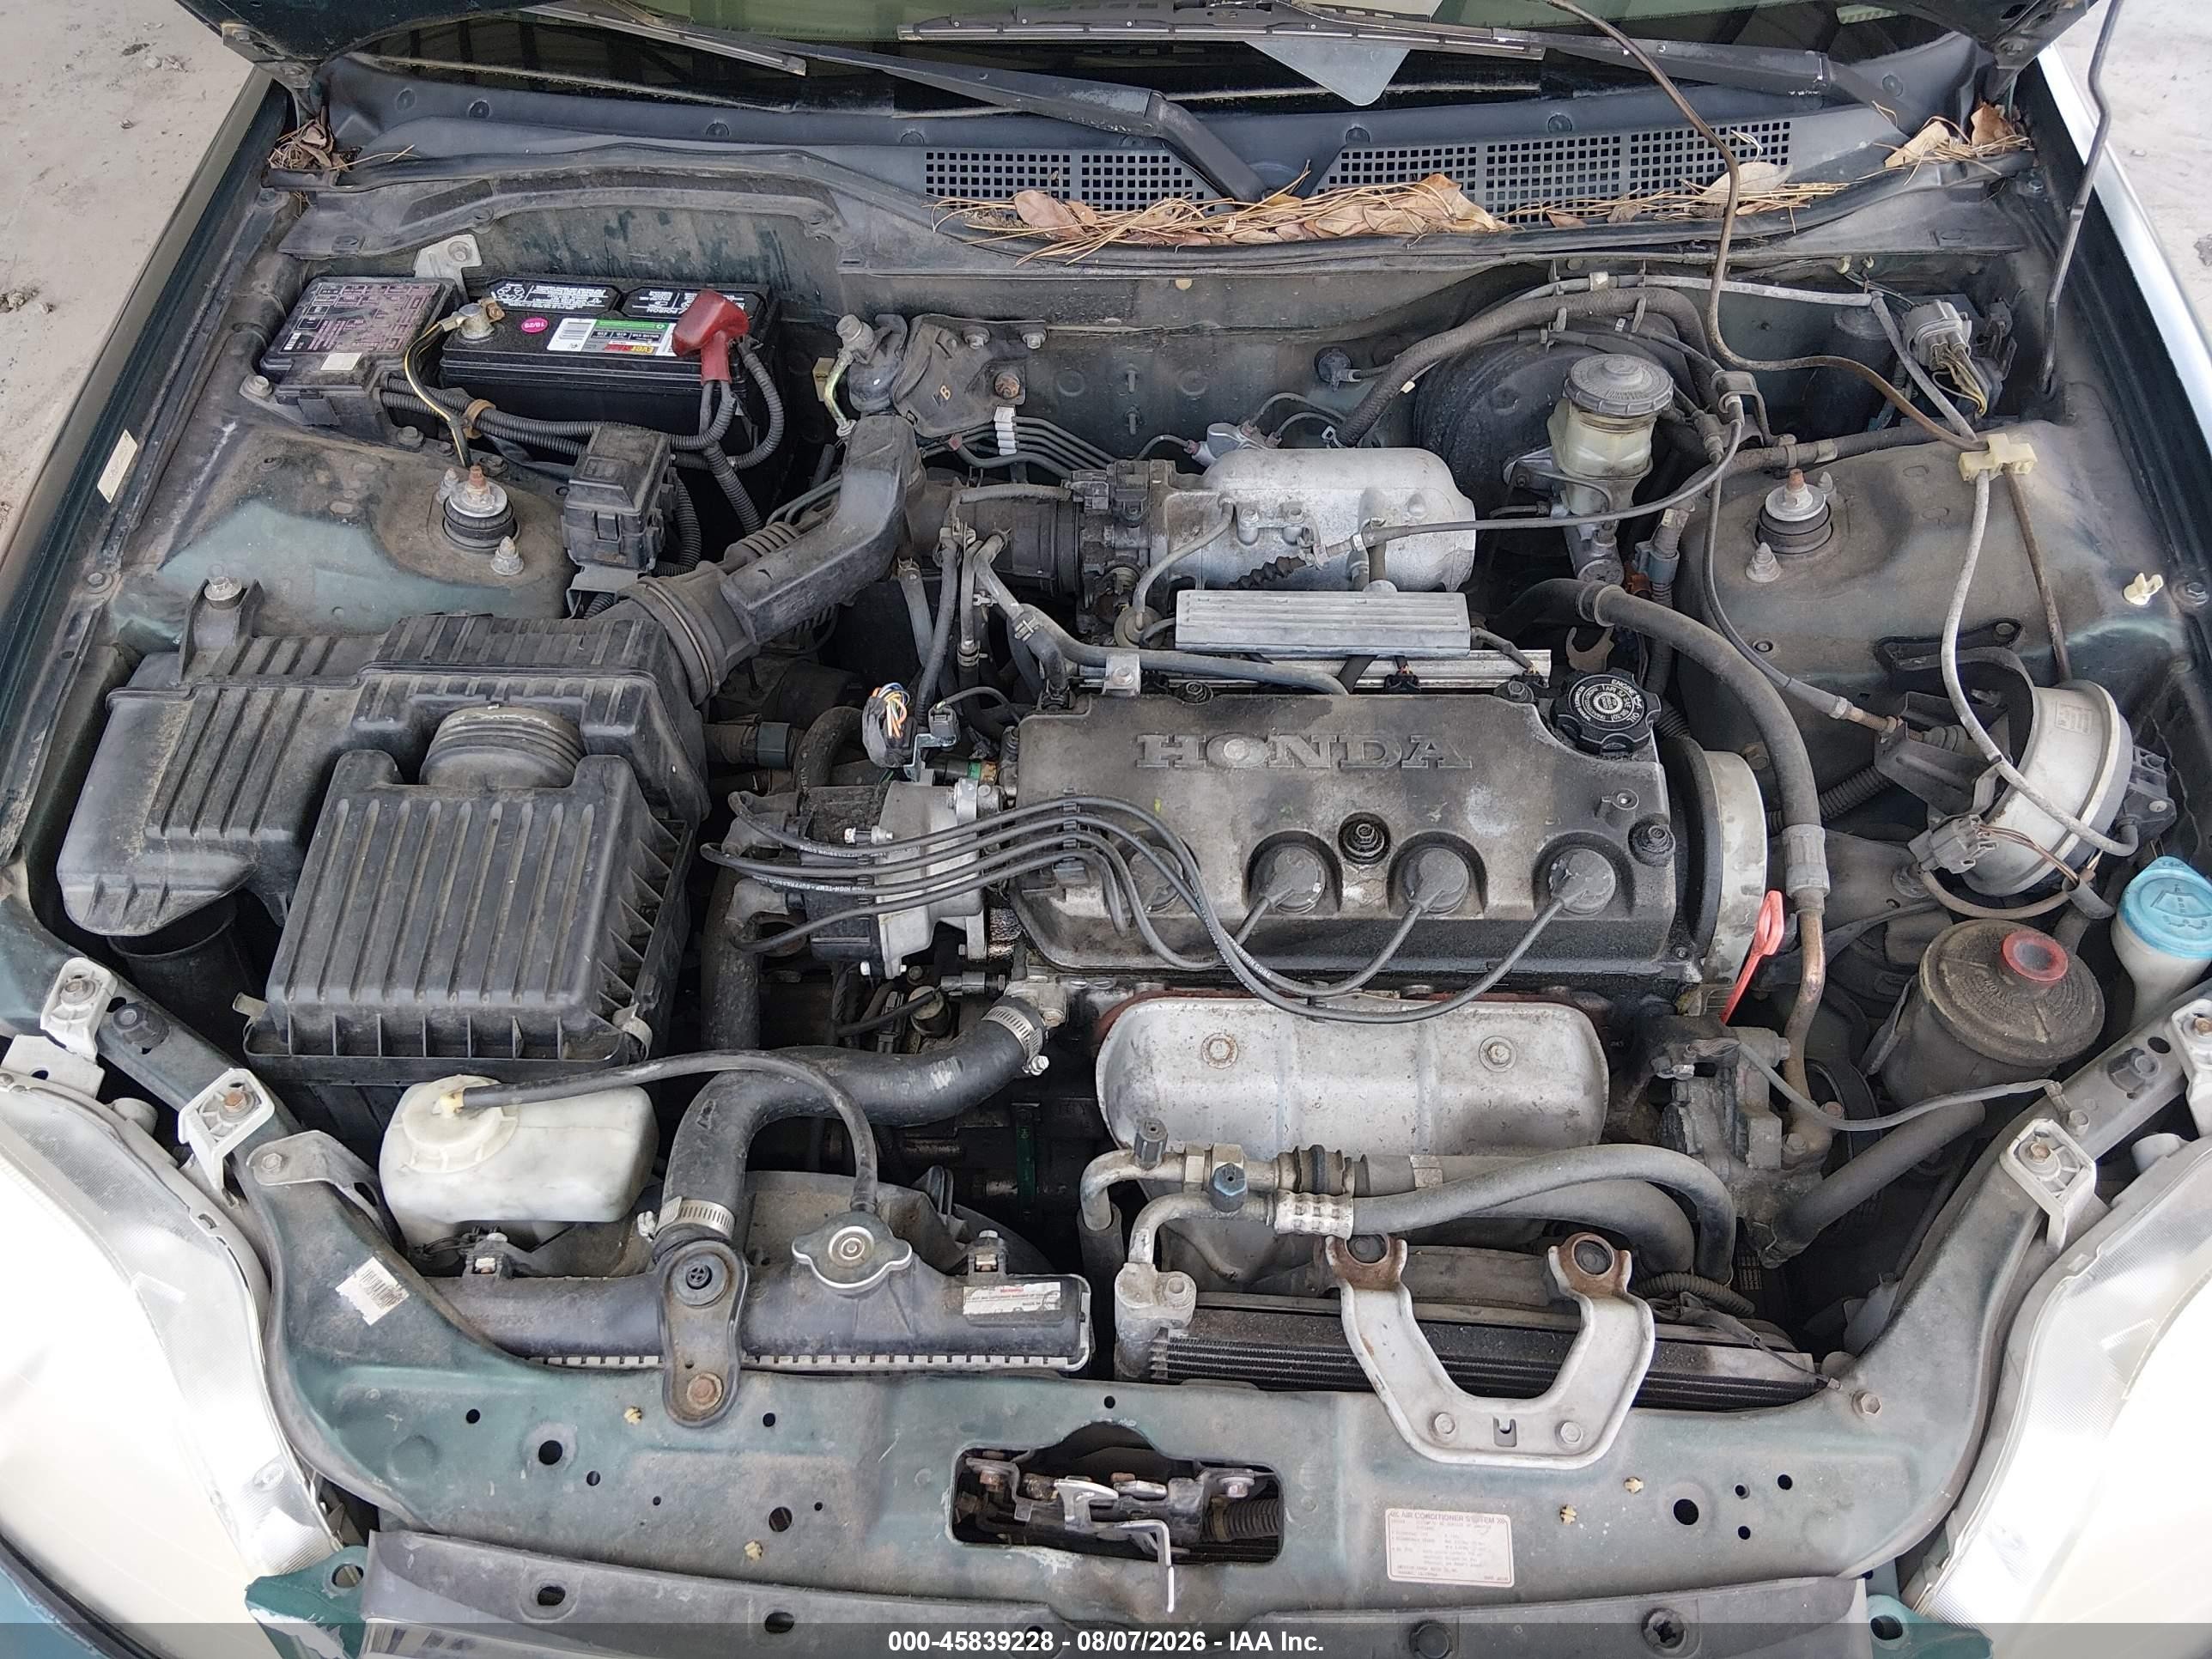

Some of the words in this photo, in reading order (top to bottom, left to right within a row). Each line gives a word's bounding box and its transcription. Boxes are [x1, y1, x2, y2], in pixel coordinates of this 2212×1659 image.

[1611, 678, 1638, 696] ENGINE
[1627, 712, 1640, 723] OIL
[1136, 732, 1474, 769] HONDA
[816, 884, 851, 893] HIGH-TEMP
[1414, 1512, 1464, 1522] CONDITIONER
